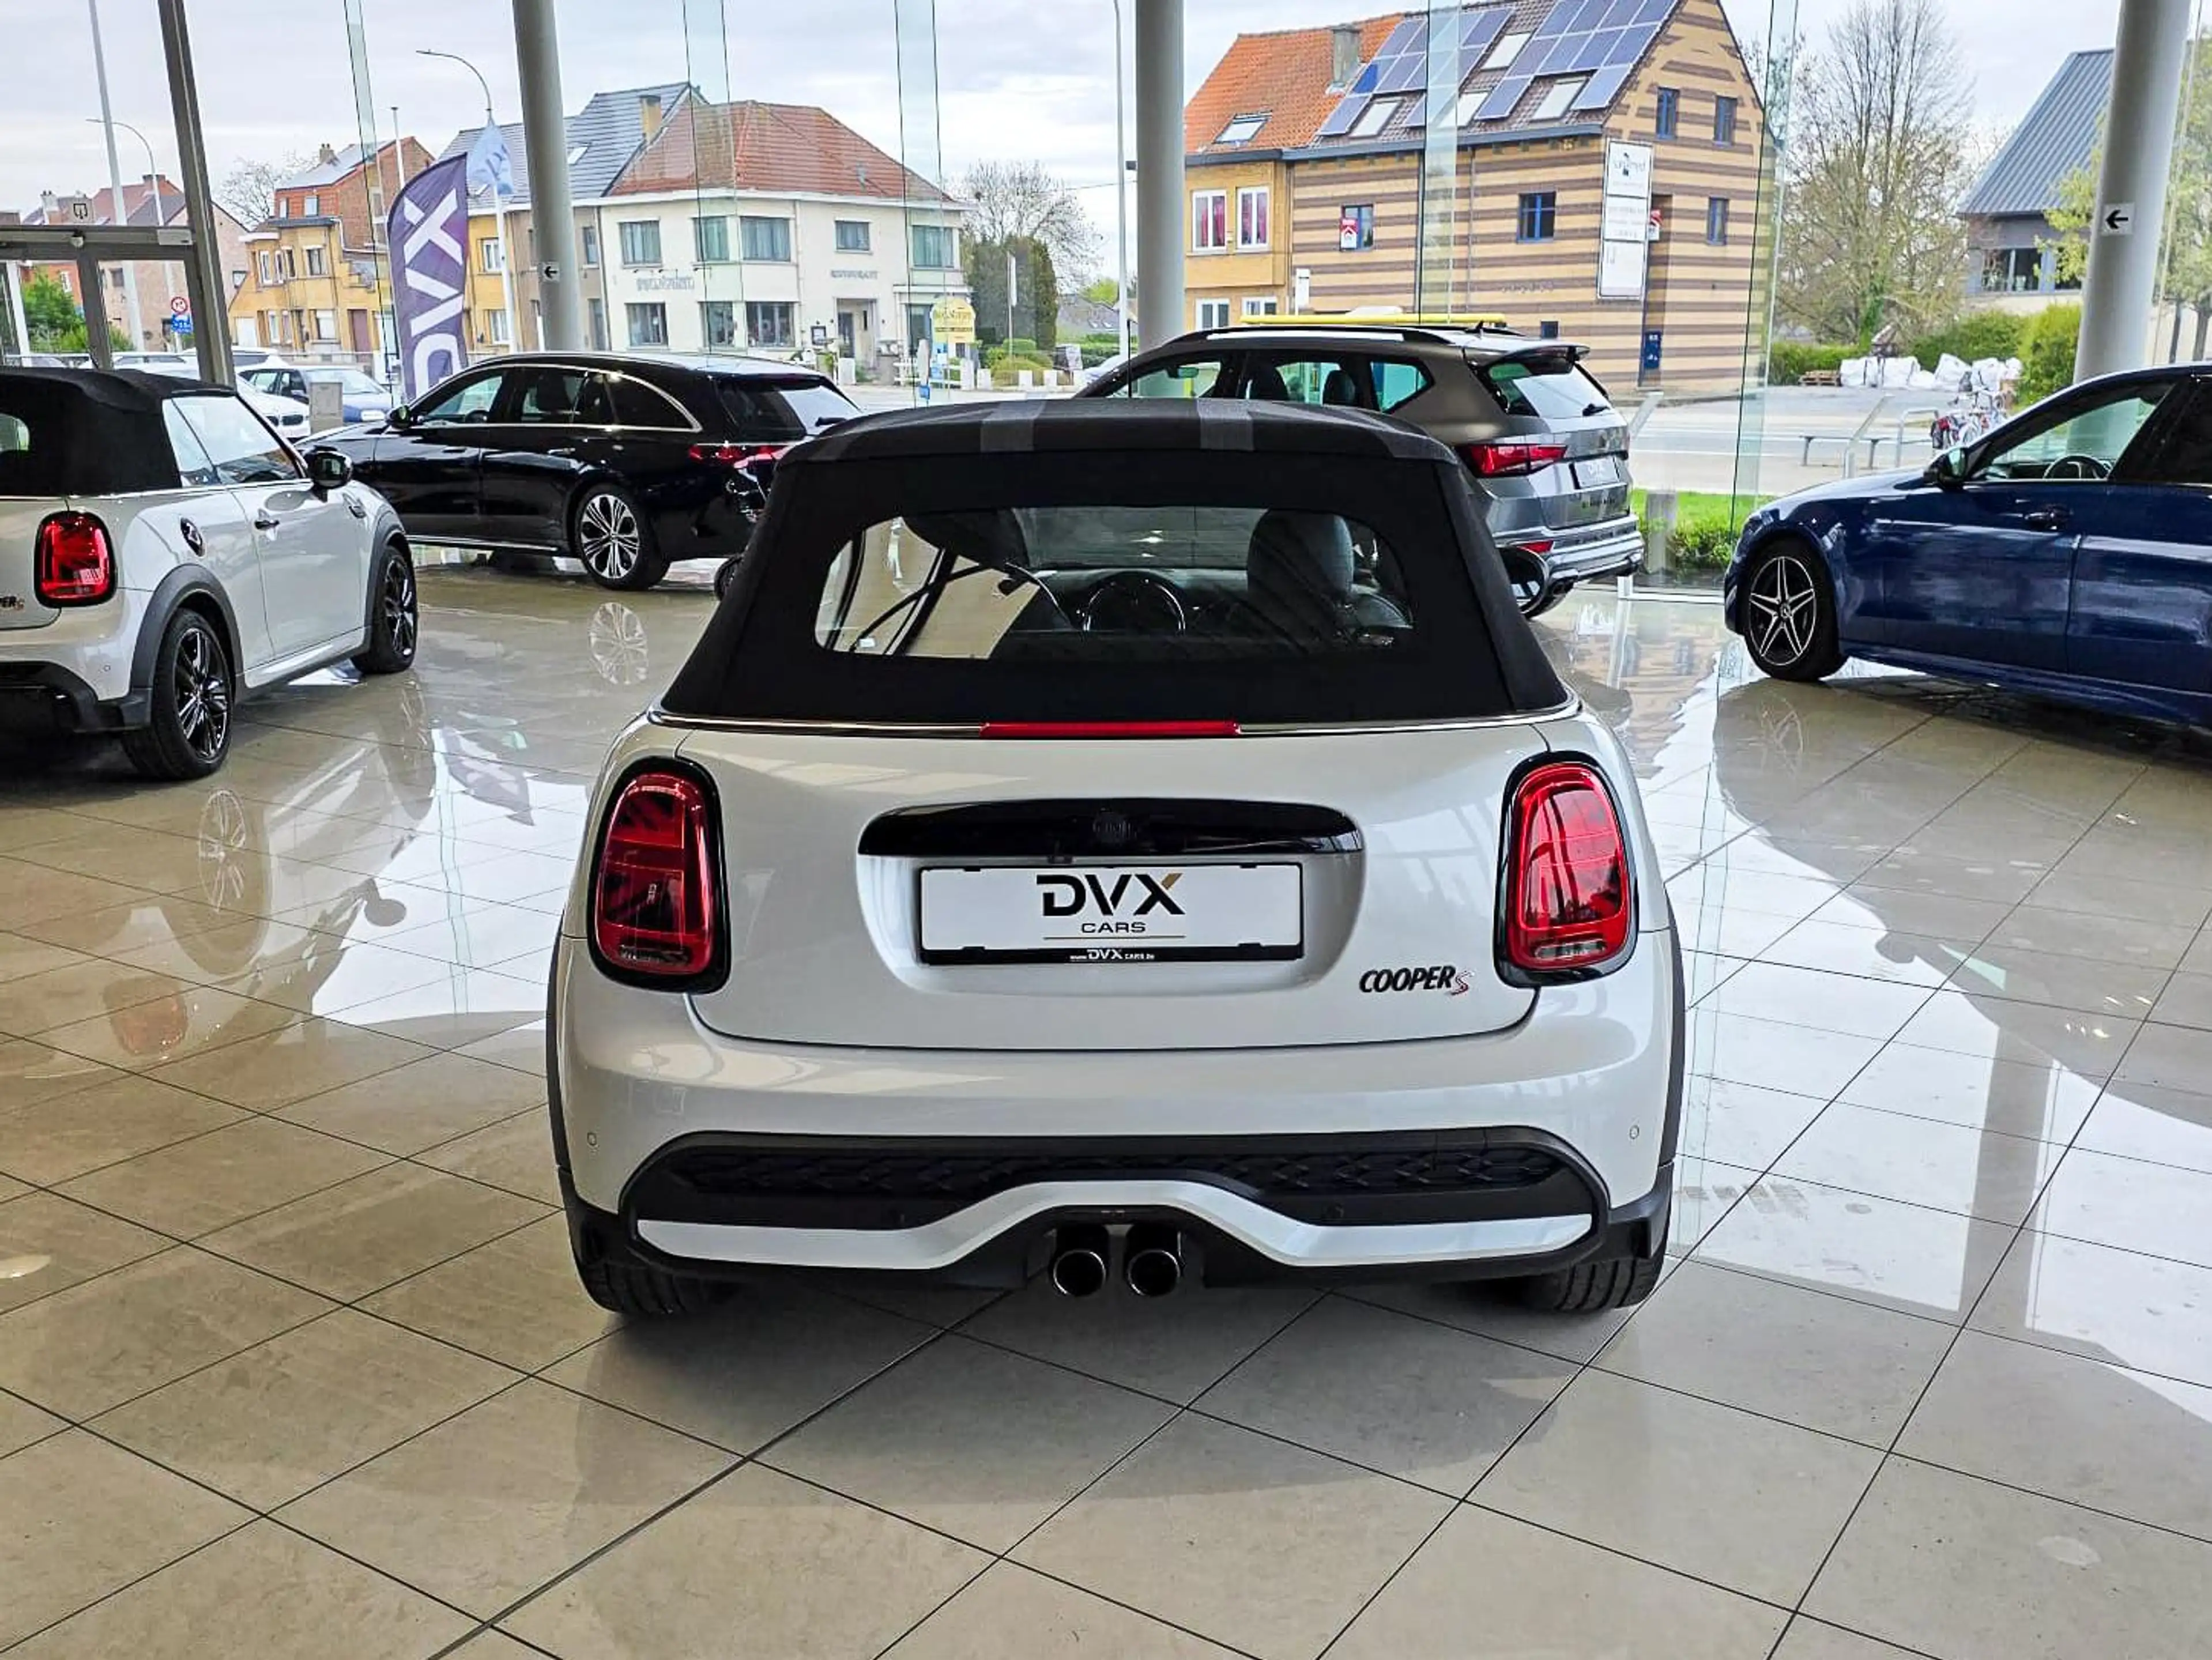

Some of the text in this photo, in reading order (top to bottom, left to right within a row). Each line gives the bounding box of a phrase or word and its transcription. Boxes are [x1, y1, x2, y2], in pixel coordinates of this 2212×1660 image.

[404, 188, 463, 402] DVX
[1036, 872, 1186, 916] DVX
[1081, 922, 1146, 933] CARS
[1359, 965, 1456, 993] COOPER
